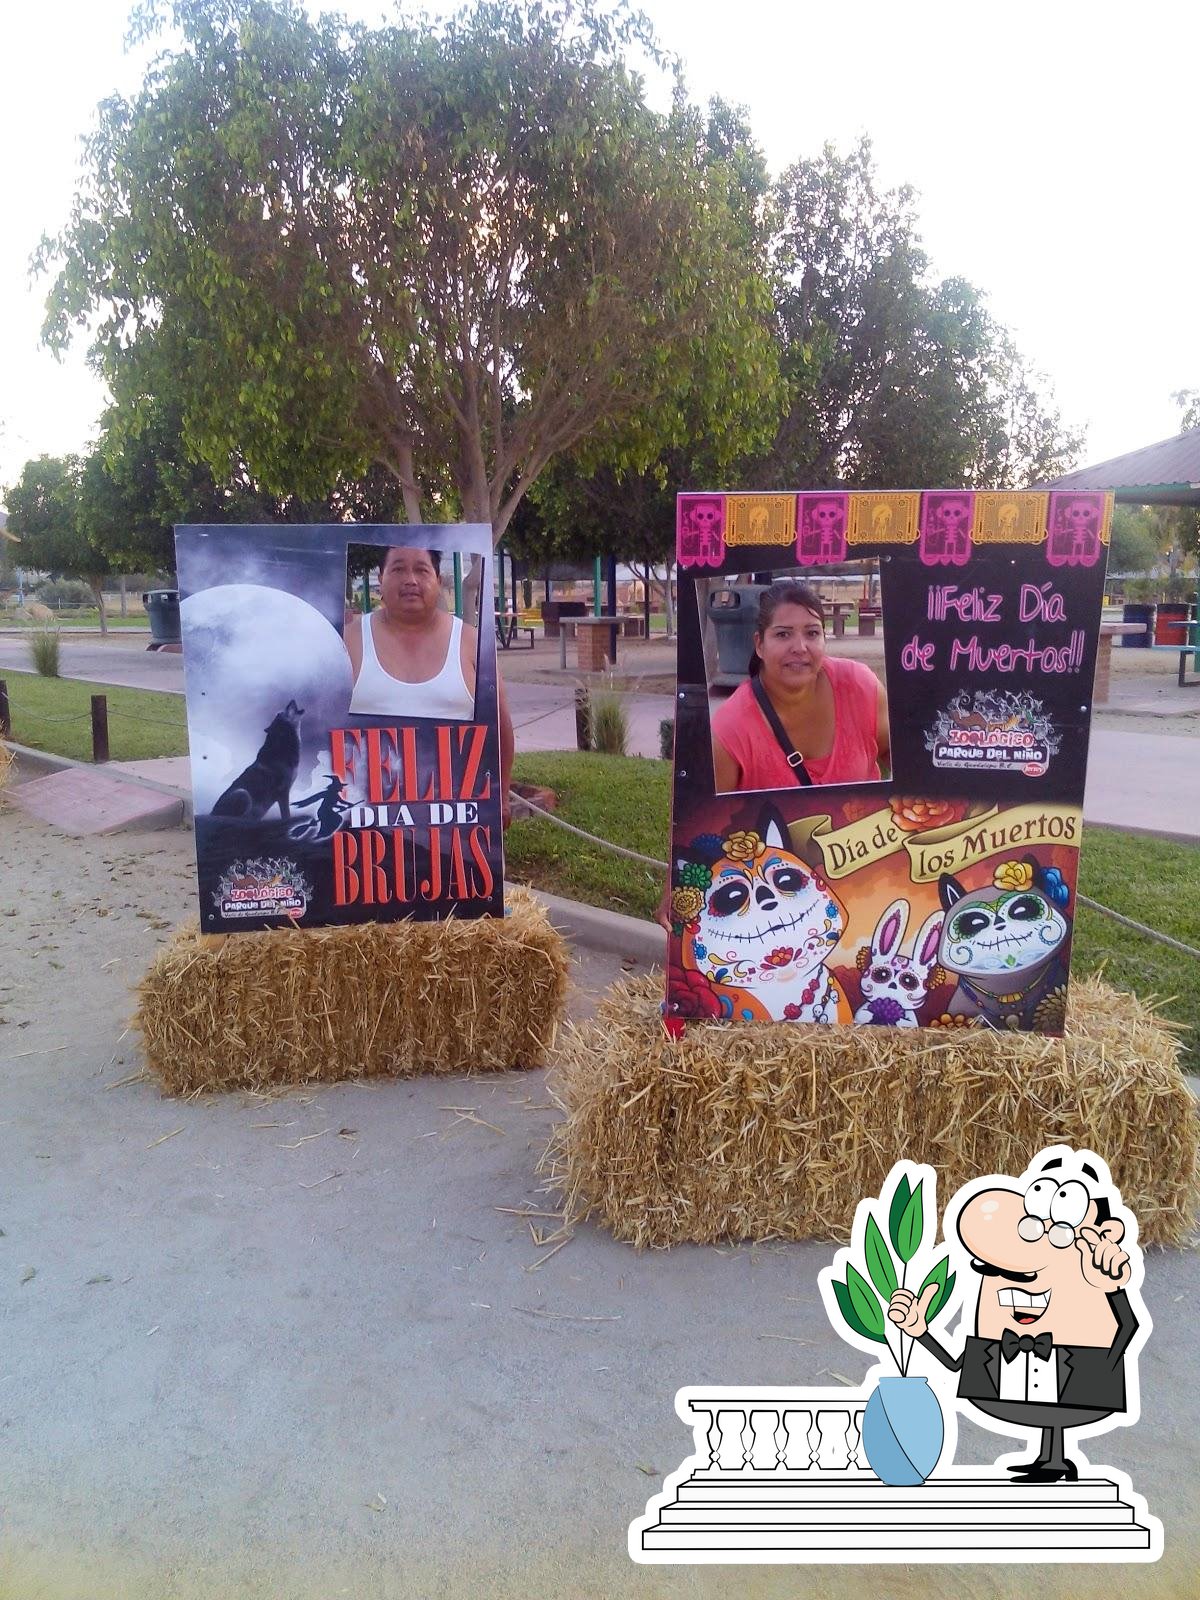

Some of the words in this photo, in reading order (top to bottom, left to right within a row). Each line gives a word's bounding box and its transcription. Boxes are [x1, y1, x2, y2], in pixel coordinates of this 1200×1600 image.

[1018, 581, 1067, 623] Día
[901, 635, 935, 671] de
[950, 630, 1085, 673] Muertos!!
[328, 725, 491, 804] FELIZ
[350, 804, 415, 828] DIA
[428, 802, 478, 825] DE
[333, 825, 494, 906] BRUJAS
[827, 836, 869, 871] Día
[872, 824, 899, 850] de
[918, 848, 955, 877] los
[961, 812, 1077, 862] Muertos
